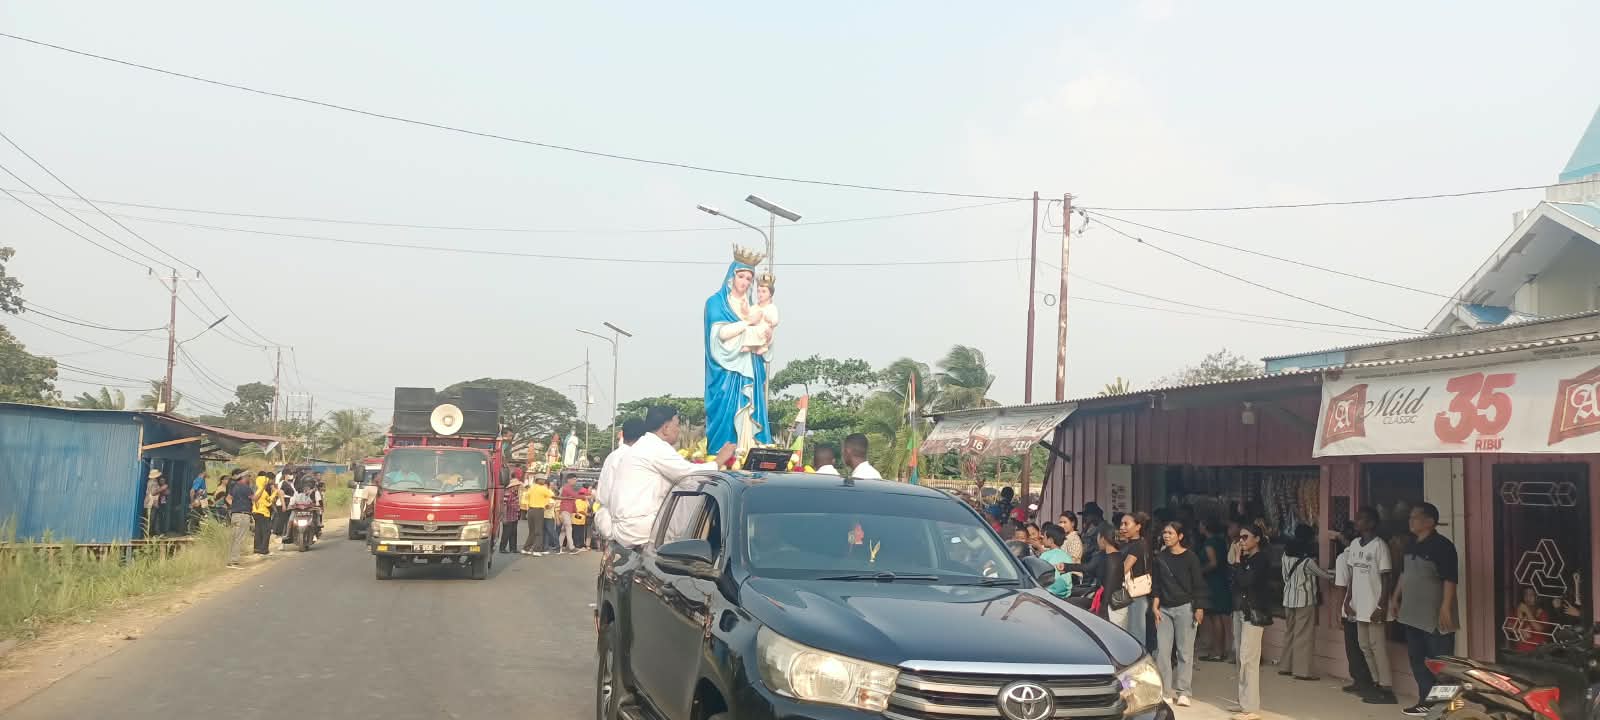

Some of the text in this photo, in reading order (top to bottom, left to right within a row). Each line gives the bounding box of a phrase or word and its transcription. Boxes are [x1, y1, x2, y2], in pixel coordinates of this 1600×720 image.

[1361, 386, 1431, 417] Mild
[1434, 372, 1516, 443] 35
[1383, 415, 1417, 425] CLASSIC
[973, 440, 984, 450] 16
